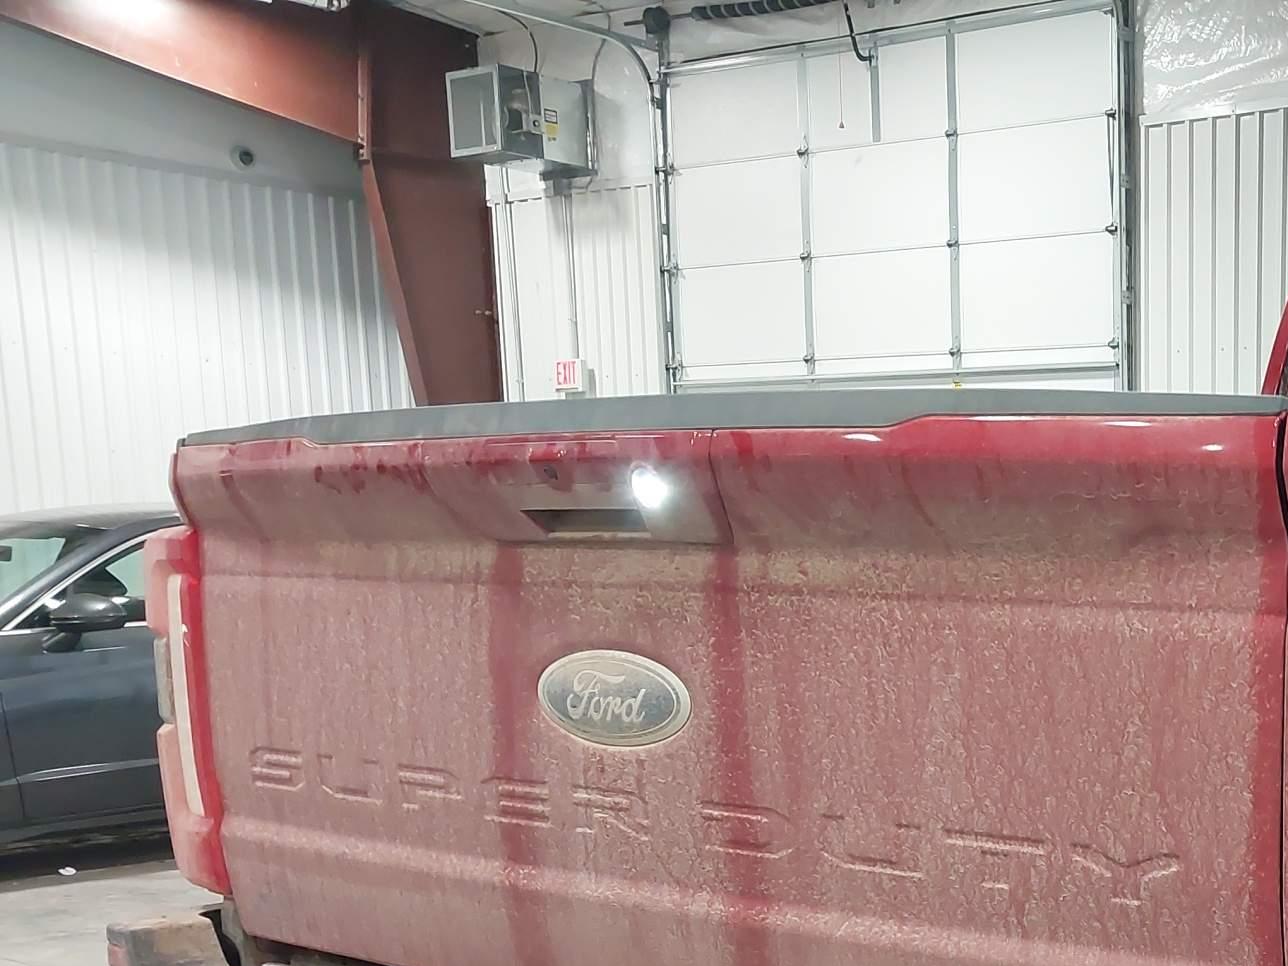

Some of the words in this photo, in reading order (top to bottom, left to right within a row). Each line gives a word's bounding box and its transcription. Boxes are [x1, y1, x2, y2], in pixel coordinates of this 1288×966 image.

[556, 361, 577, 386] EXIT
[566, 669, 647, 722] Ford
[249, 746, 650, 841] SUPER
[694, 800, 1181, 905] DUTY
